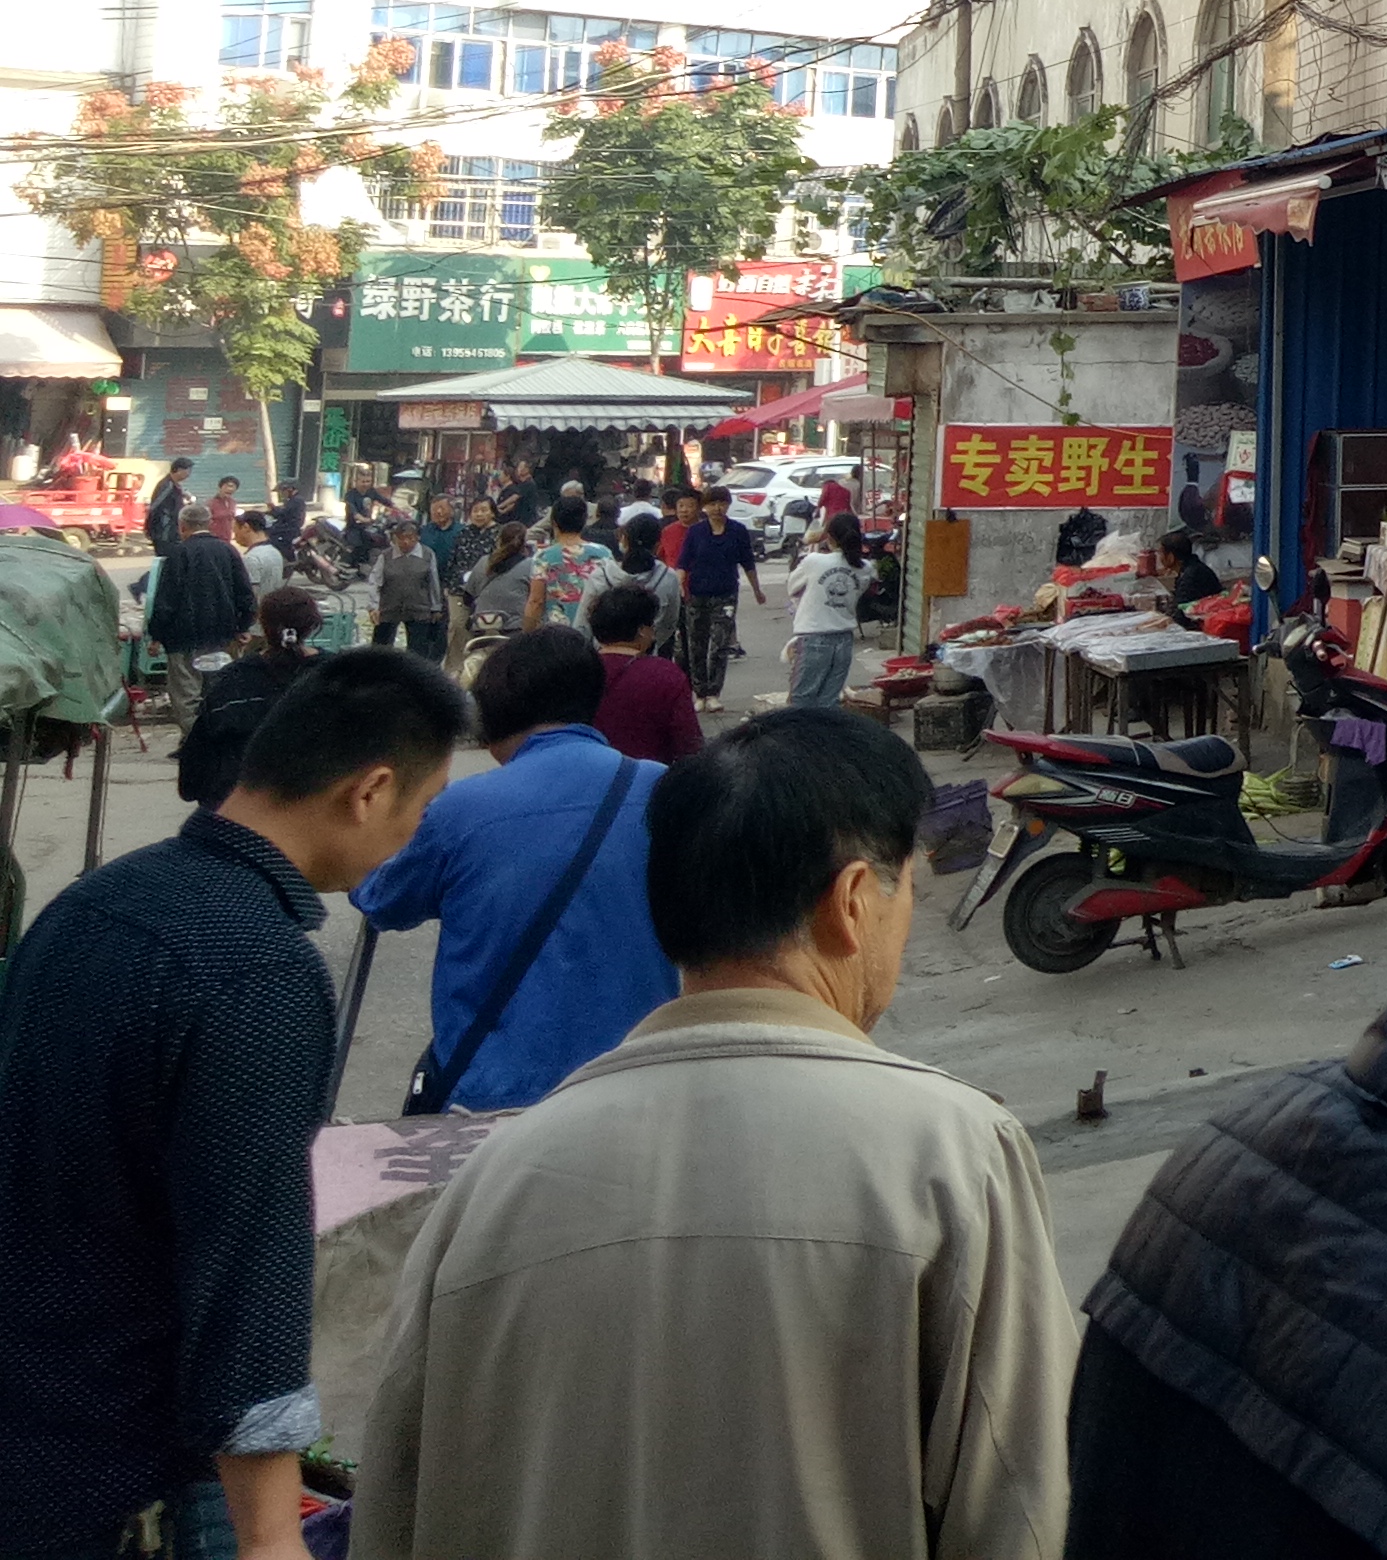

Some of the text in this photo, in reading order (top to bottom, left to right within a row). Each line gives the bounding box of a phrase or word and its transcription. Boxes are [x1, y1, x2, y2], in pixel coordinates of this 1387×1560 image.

[360, 273, 515, 324] 绿野茶行
[950, 433, 1172, 497] 专卖野生
